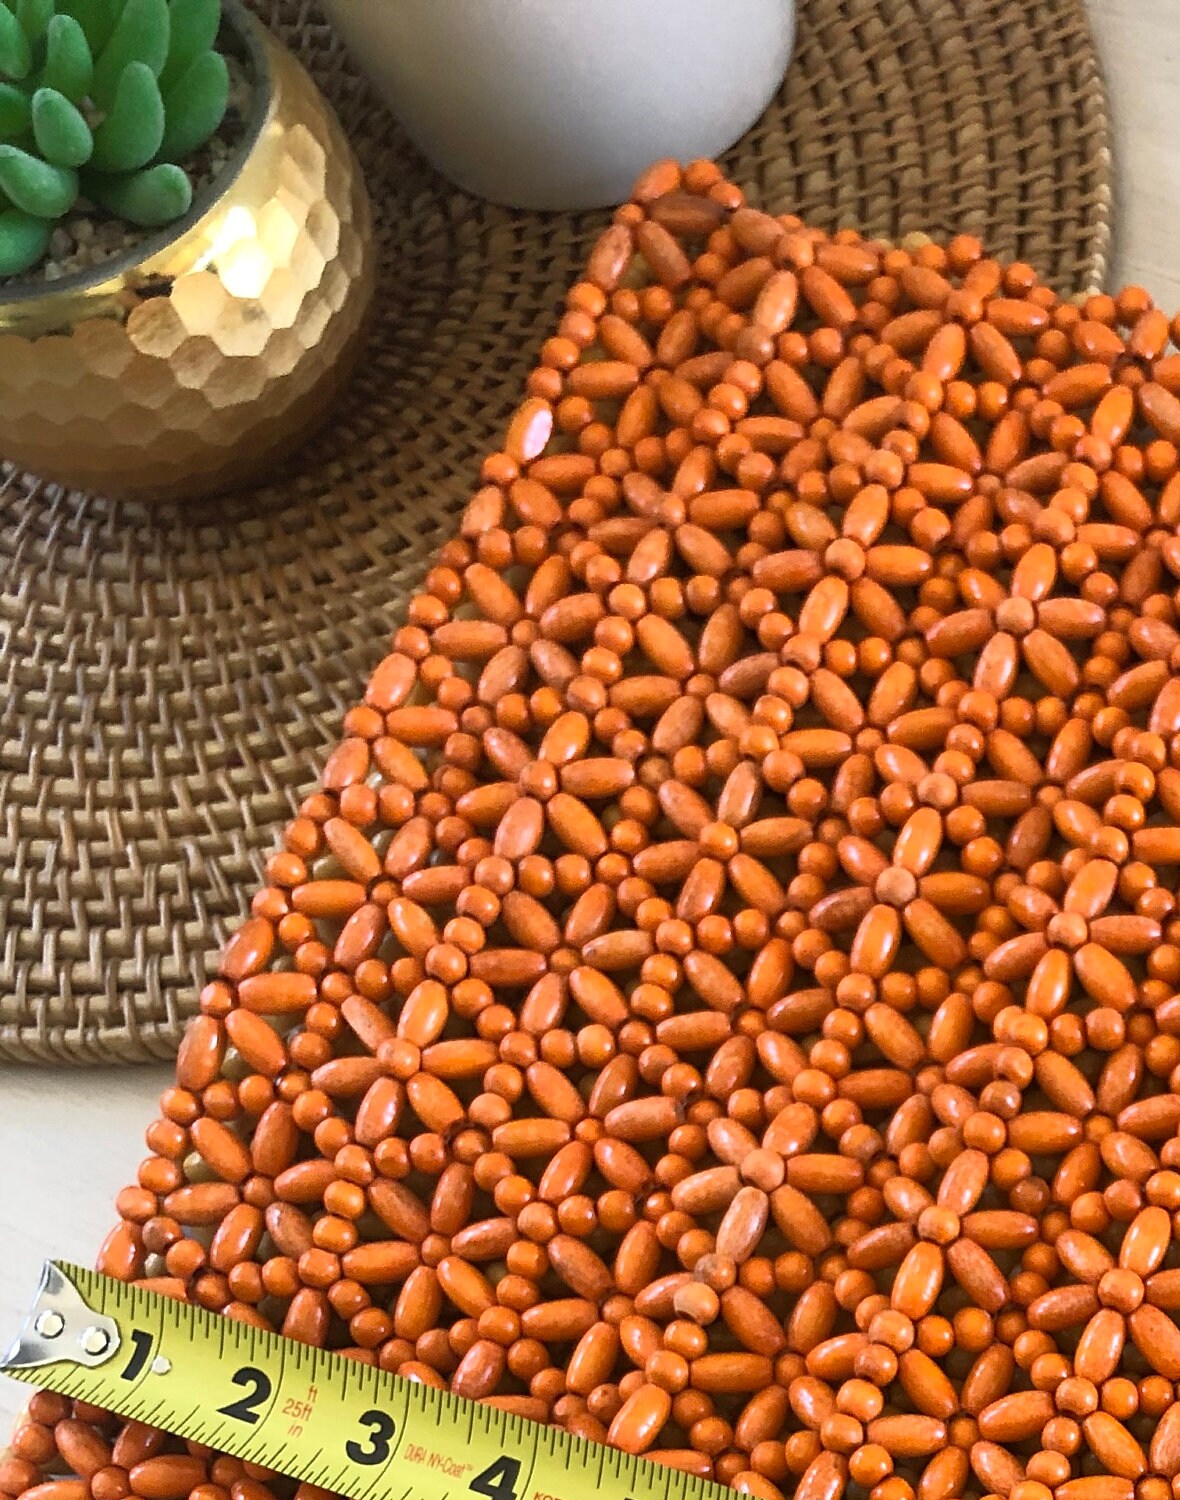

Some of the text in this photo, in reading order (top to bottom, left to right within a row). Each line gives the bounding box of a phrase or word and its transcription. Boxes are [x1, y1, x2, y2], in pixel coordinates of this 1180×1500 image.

[120, 1329, 153, 1381] 1
[217, 1366, 272, 1423] 2
[281, 1398, 312, 1421] 25ft
[346, 1410, 396, 1465] 3
